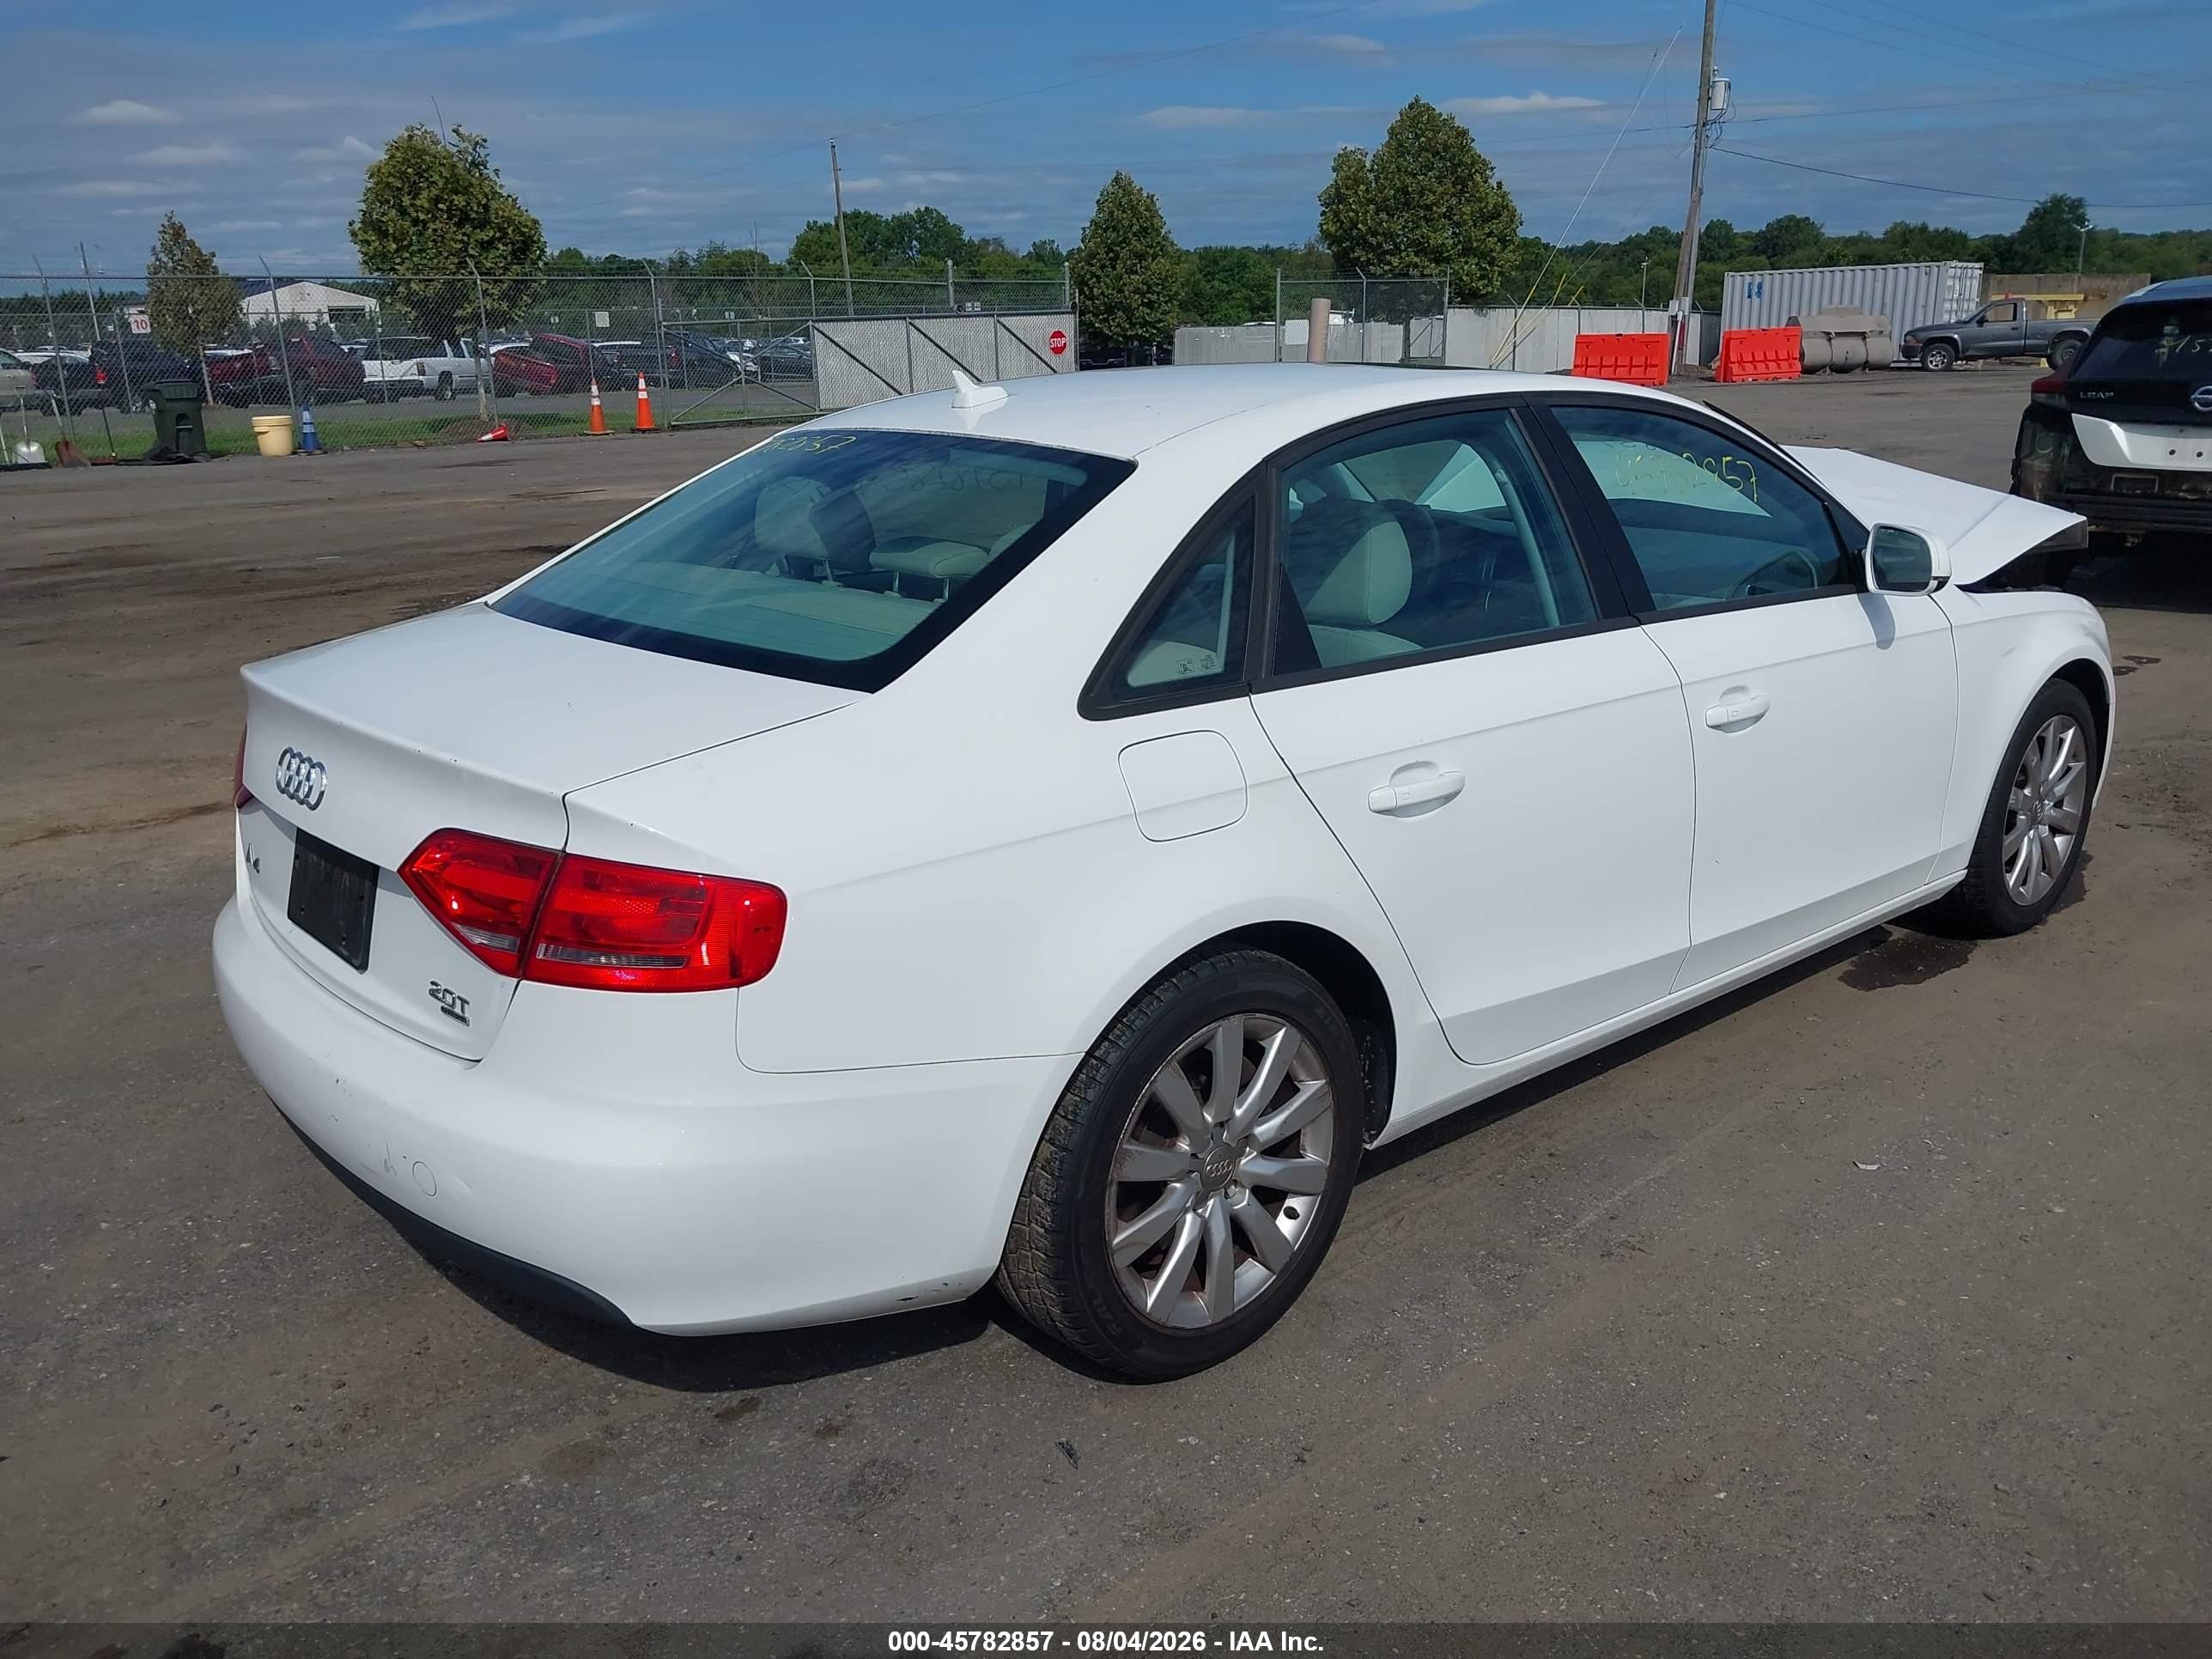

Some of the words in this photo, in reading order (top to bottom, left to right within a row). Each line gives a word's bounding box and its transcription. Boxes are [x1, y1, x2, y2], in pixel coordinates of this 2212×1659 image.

[133, 319, 148, 331] 10
[1050, 337, 1066, 349] STOP
[2079, 391, 2115, 399] LEAF
[245, 842, 261, 875] A4
